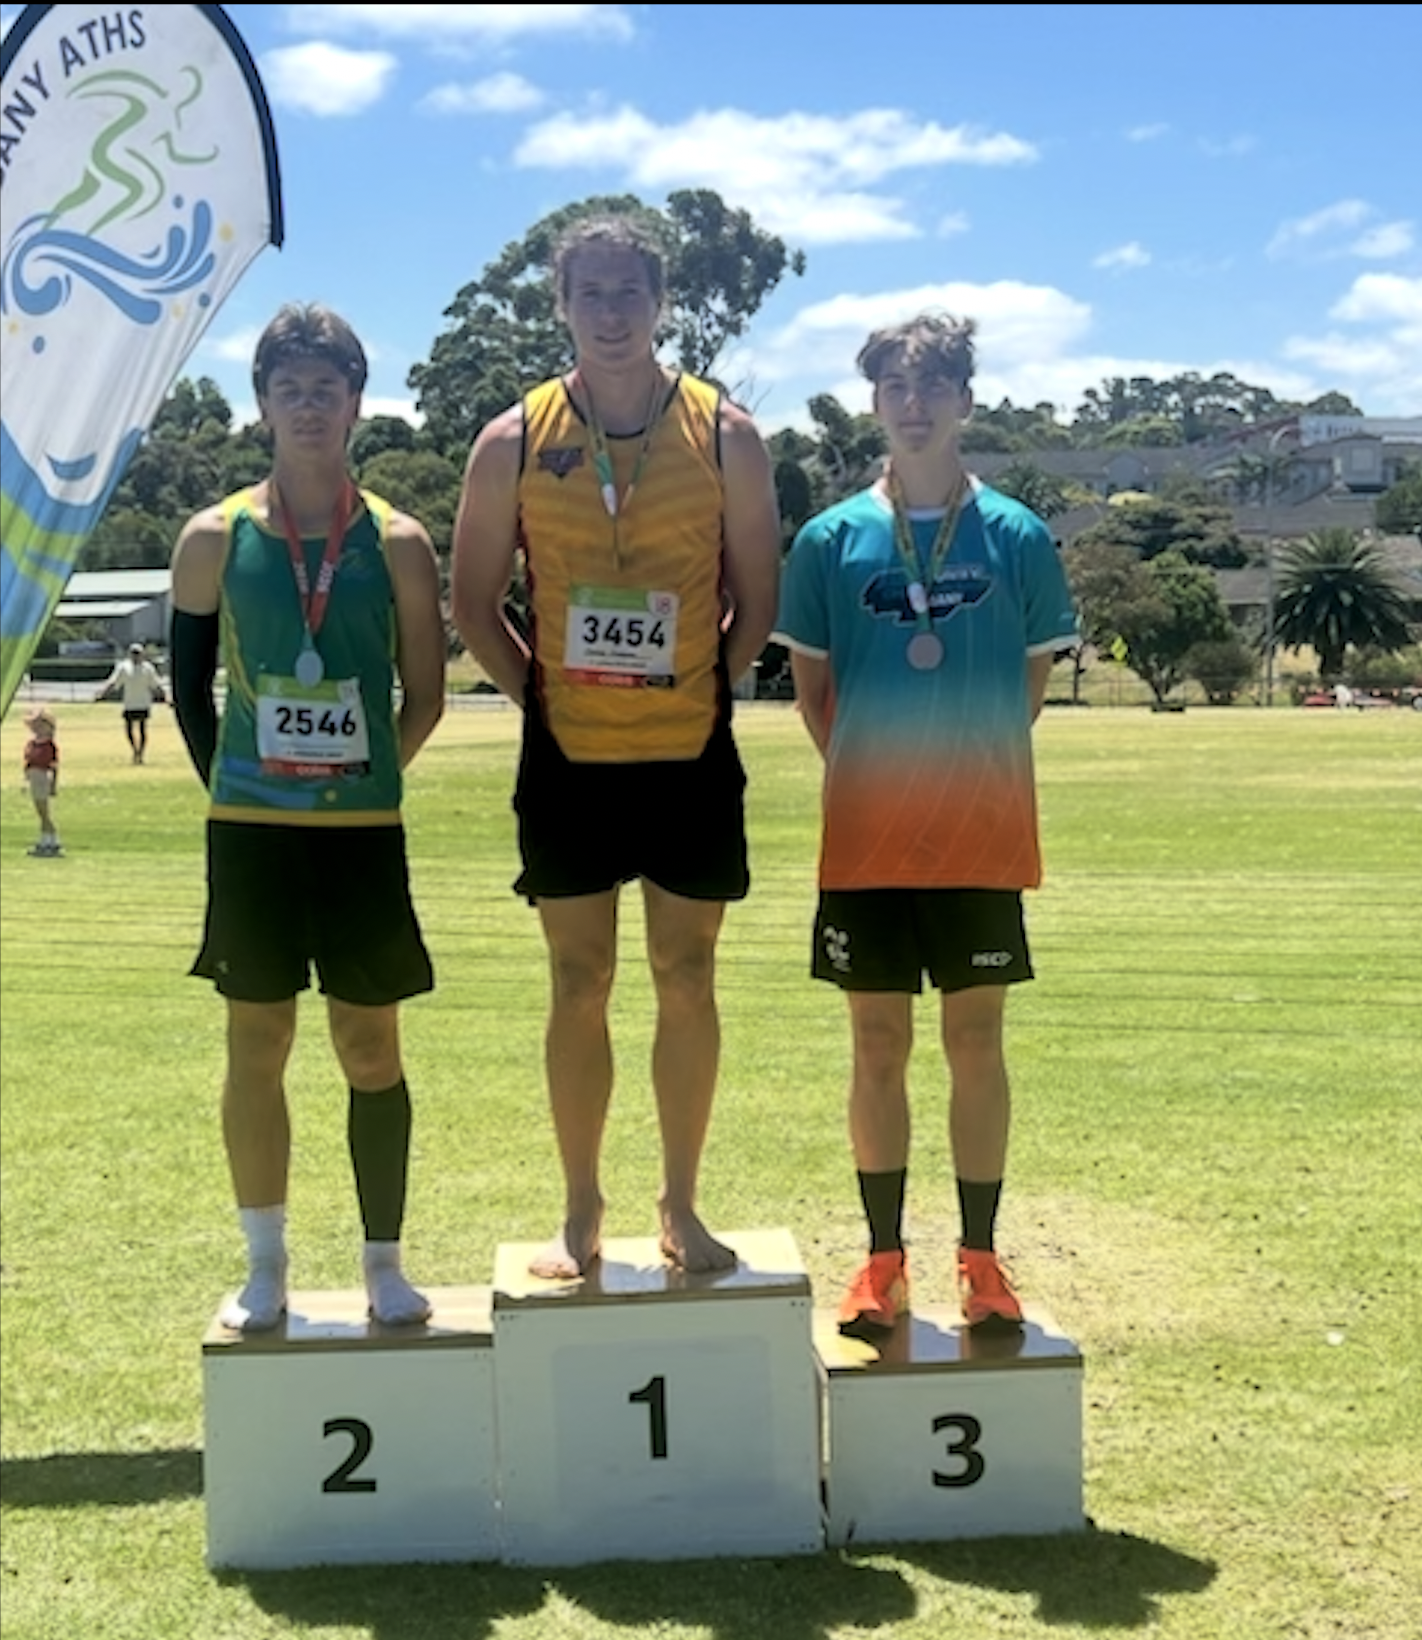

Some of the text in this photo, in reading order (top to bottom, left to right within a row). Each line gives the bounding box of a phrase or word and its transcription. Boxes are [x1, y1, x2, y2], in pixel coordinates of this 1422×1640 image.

[0, 10, 146, 187] ANY ATHS
[583, 615, 665, 650] 3454
[275, 706, 357, 737] 2546
[321, 1417, 378, 1494] 2
[628, 1375, 669, 1461] 1
[931, 1412, 986, 1490] 3
